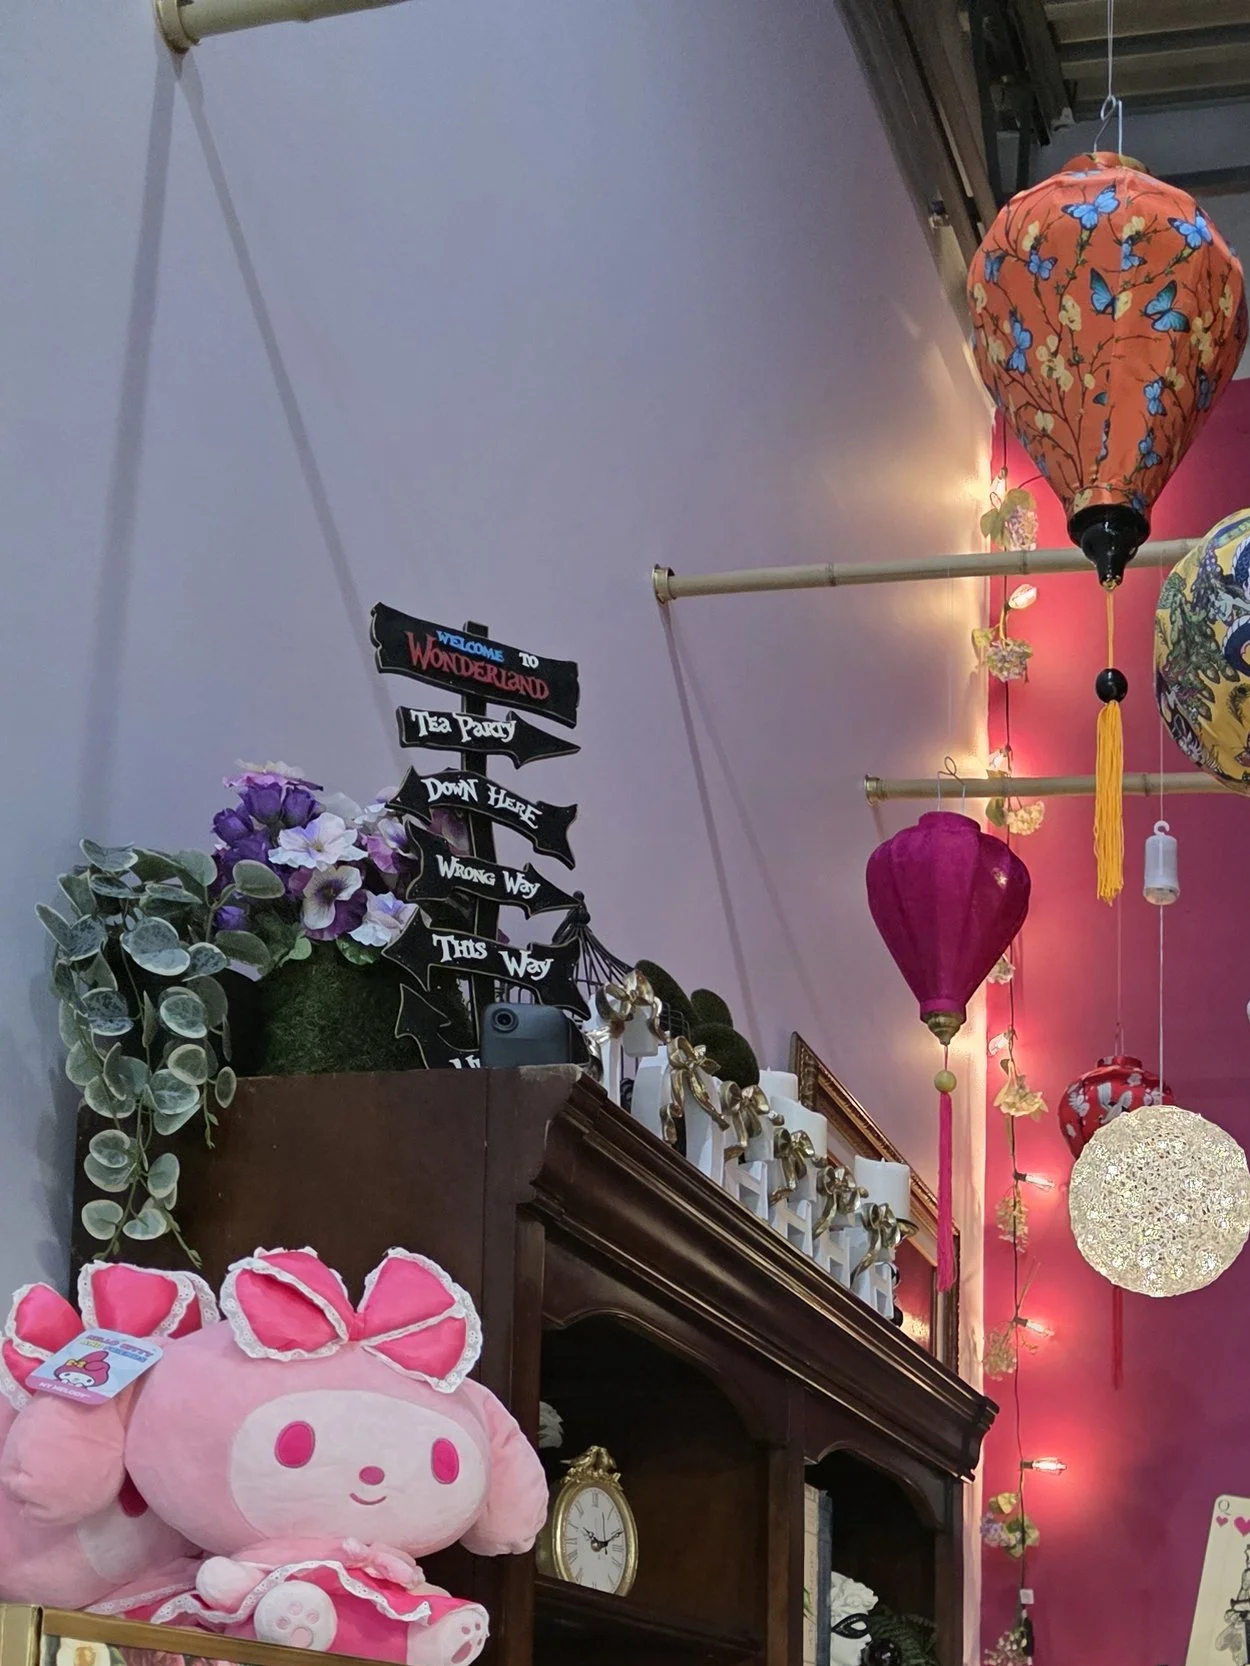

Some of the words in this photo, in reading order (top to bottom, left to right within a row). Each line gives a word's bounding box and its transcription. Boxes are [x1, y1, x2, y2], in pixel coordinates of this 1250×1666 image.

[436, 630, 504, 662] WELCOME
[519, 652, 539, 669] TO
[487, 784, 543, 829] HERE
[1218, 1500, 1232, 1516] Q
